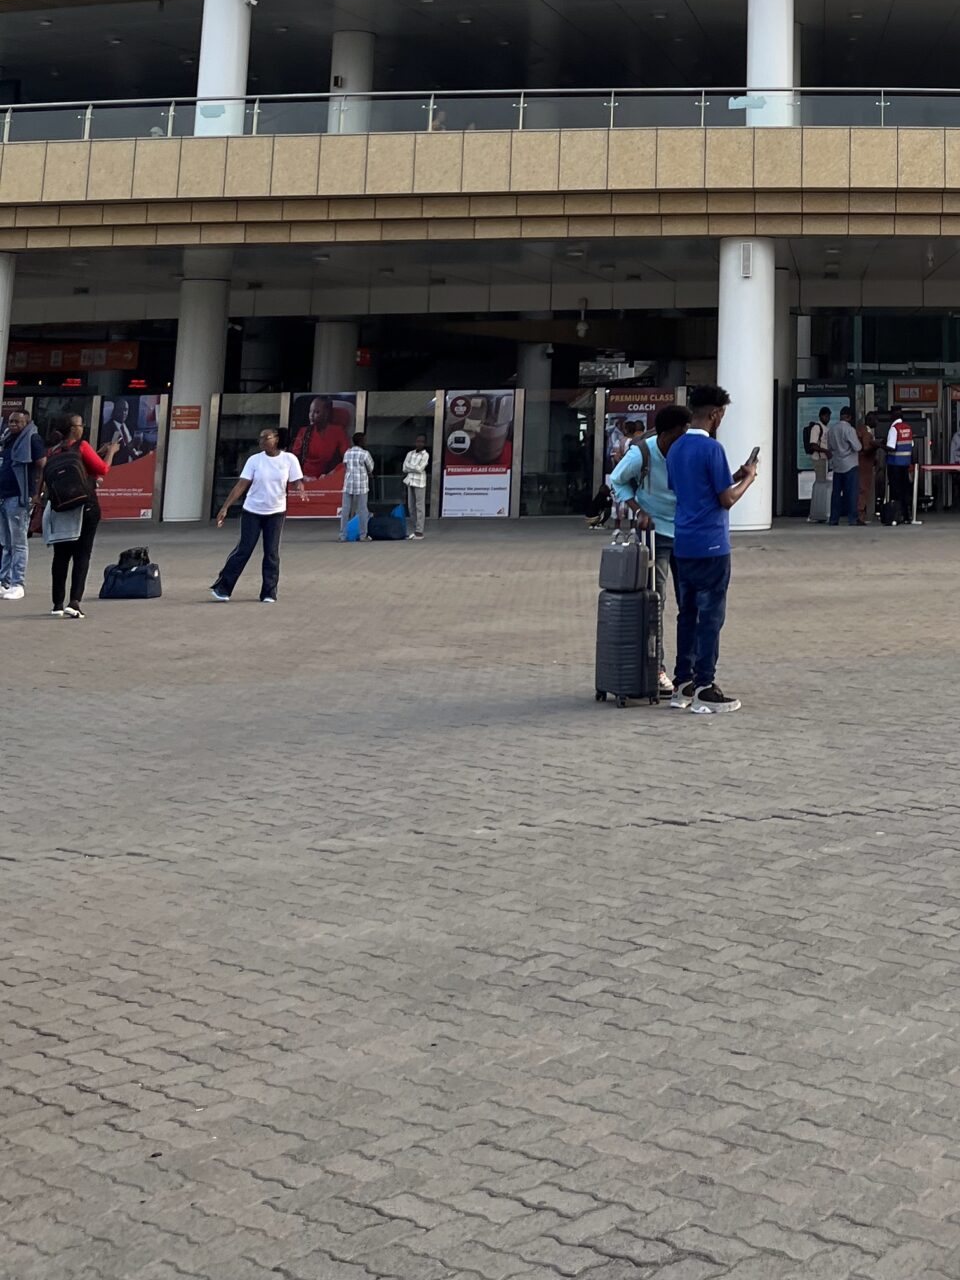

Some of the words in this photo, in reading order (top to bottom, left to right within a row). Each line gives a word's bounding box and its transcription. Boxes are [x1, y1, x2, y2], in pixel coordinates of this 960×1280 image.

[610, 393, 648, 402] PREMIUM
[649, 393, 674, 401] CLASS
[627, 403, 656, 411] COACH
